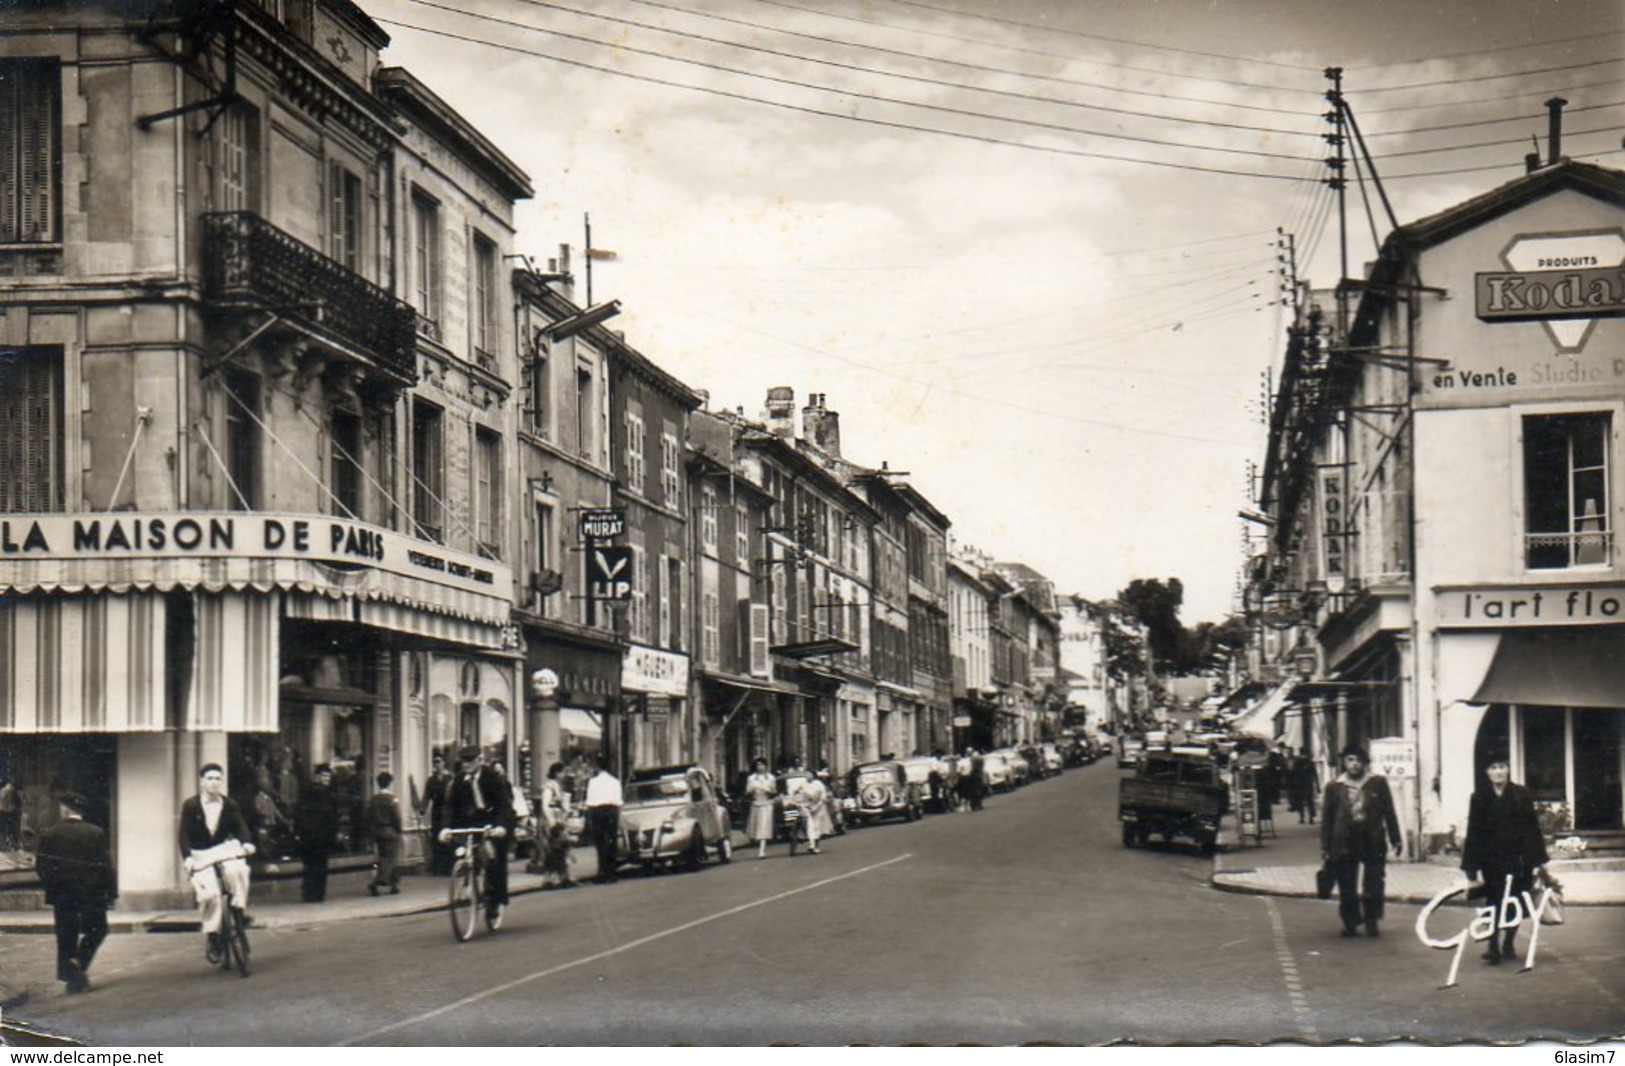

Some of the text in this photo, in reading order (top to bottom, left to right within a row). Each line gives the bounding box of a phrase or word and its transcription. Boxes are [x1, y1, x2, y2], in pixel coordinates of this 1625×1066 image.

[1537, 256, 1598, 268] PRODUITS
[1433, 374, 1454, 388] en
[1460, 366, 1517, 387] Vente
[584, 521, 624, 537] MURAT
[1324, 477, 1342, 572] KODAK
[1, 518, 385, 562] LA MAISON DE PARIS
[593, 581, 631, 599] LIP
[1465, 590, 1621, 619] l'art flo
